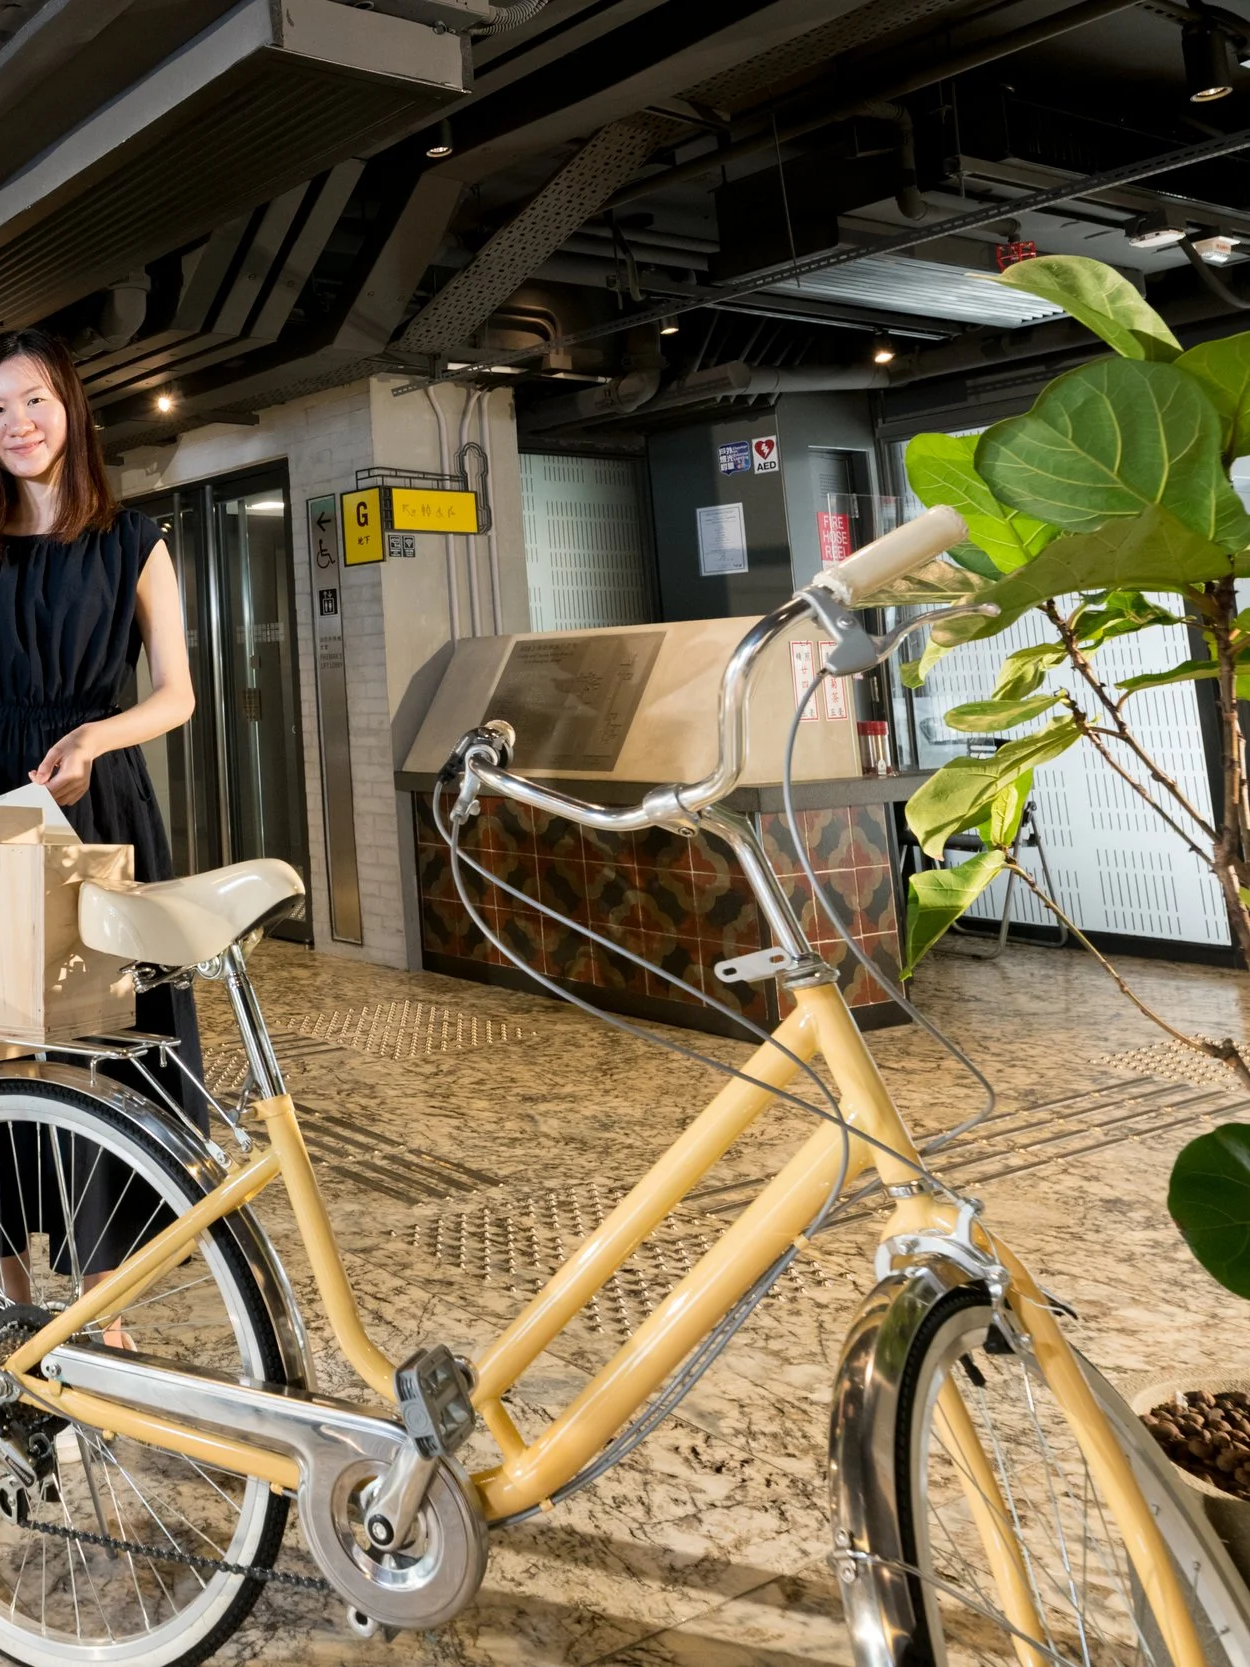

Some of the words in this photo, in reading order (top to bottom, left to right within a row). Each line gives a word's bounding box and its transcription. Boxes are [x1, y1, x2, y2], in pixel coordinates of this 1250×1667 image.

[757, 461, 777, 471] AED
[356, 501, 368, 527] G
[823, 515, 844, 530] FIRE
[358, 535, 370, 546] 地下
[822, 530, 848, 545] HOSE
